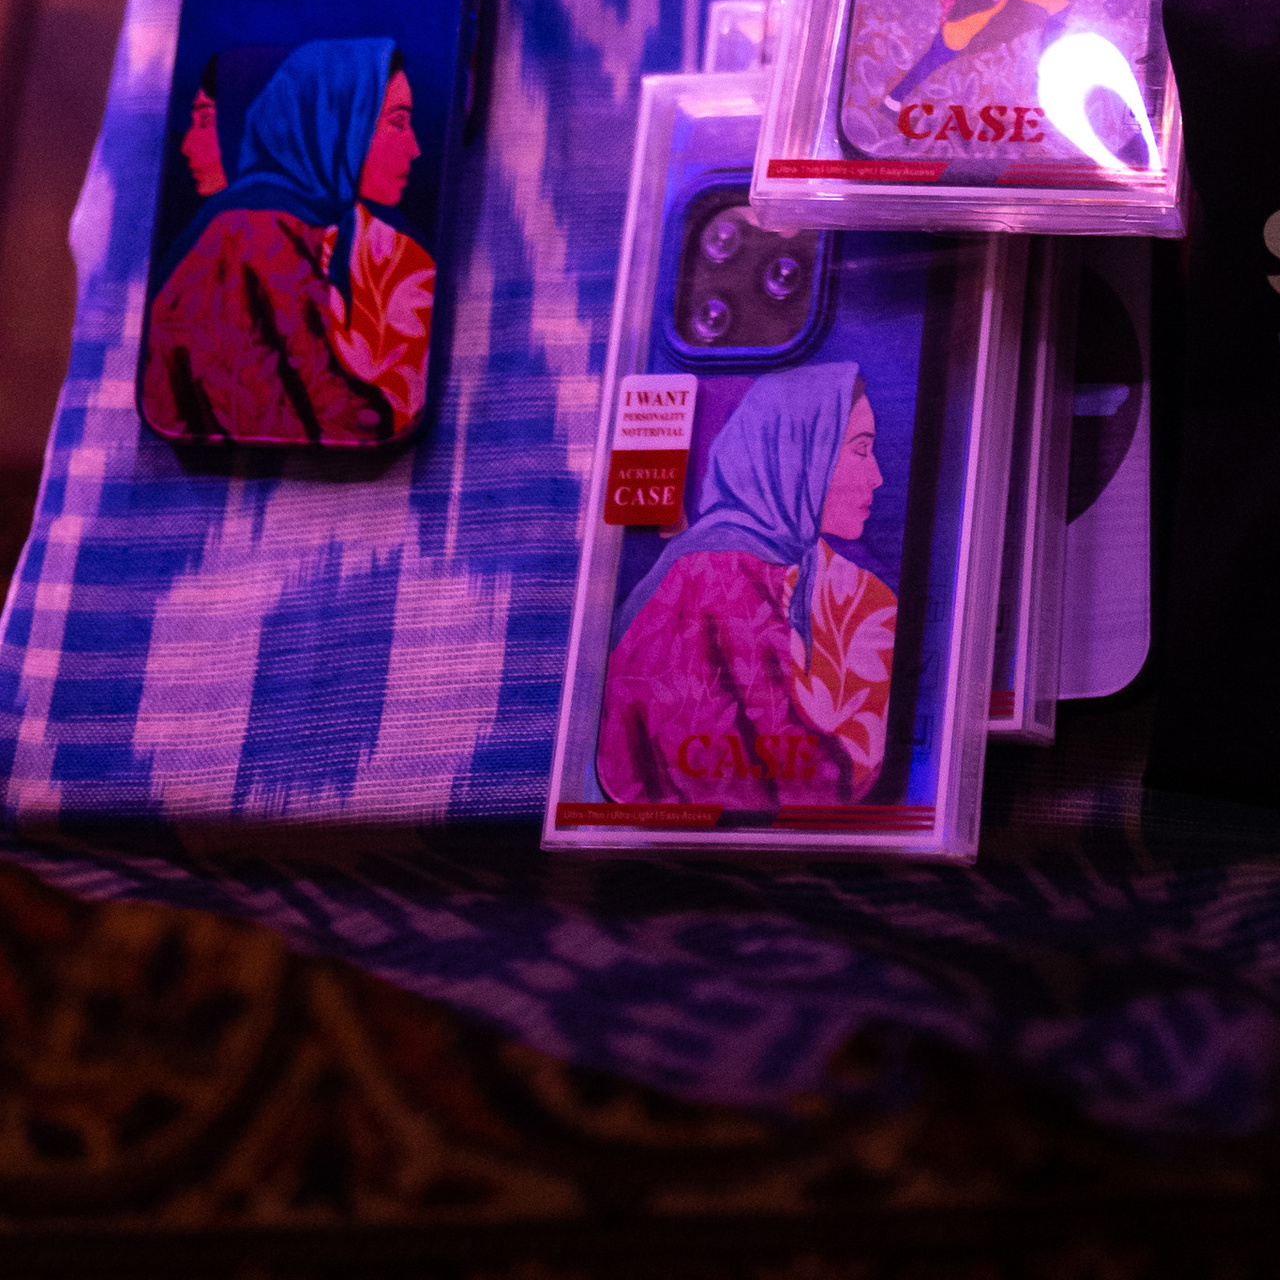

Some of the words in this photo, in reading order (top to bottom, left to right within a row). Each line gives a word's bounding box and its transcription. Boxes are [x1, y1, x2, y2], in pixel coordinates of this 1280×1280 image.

[898, 103, 1046, 143] CASE
[625, 390, 632, 407] I
[636, 390, 690, 407] WANT
[614, 485, 676, 507] CASE
[677, 733, 819, 780] CASE
